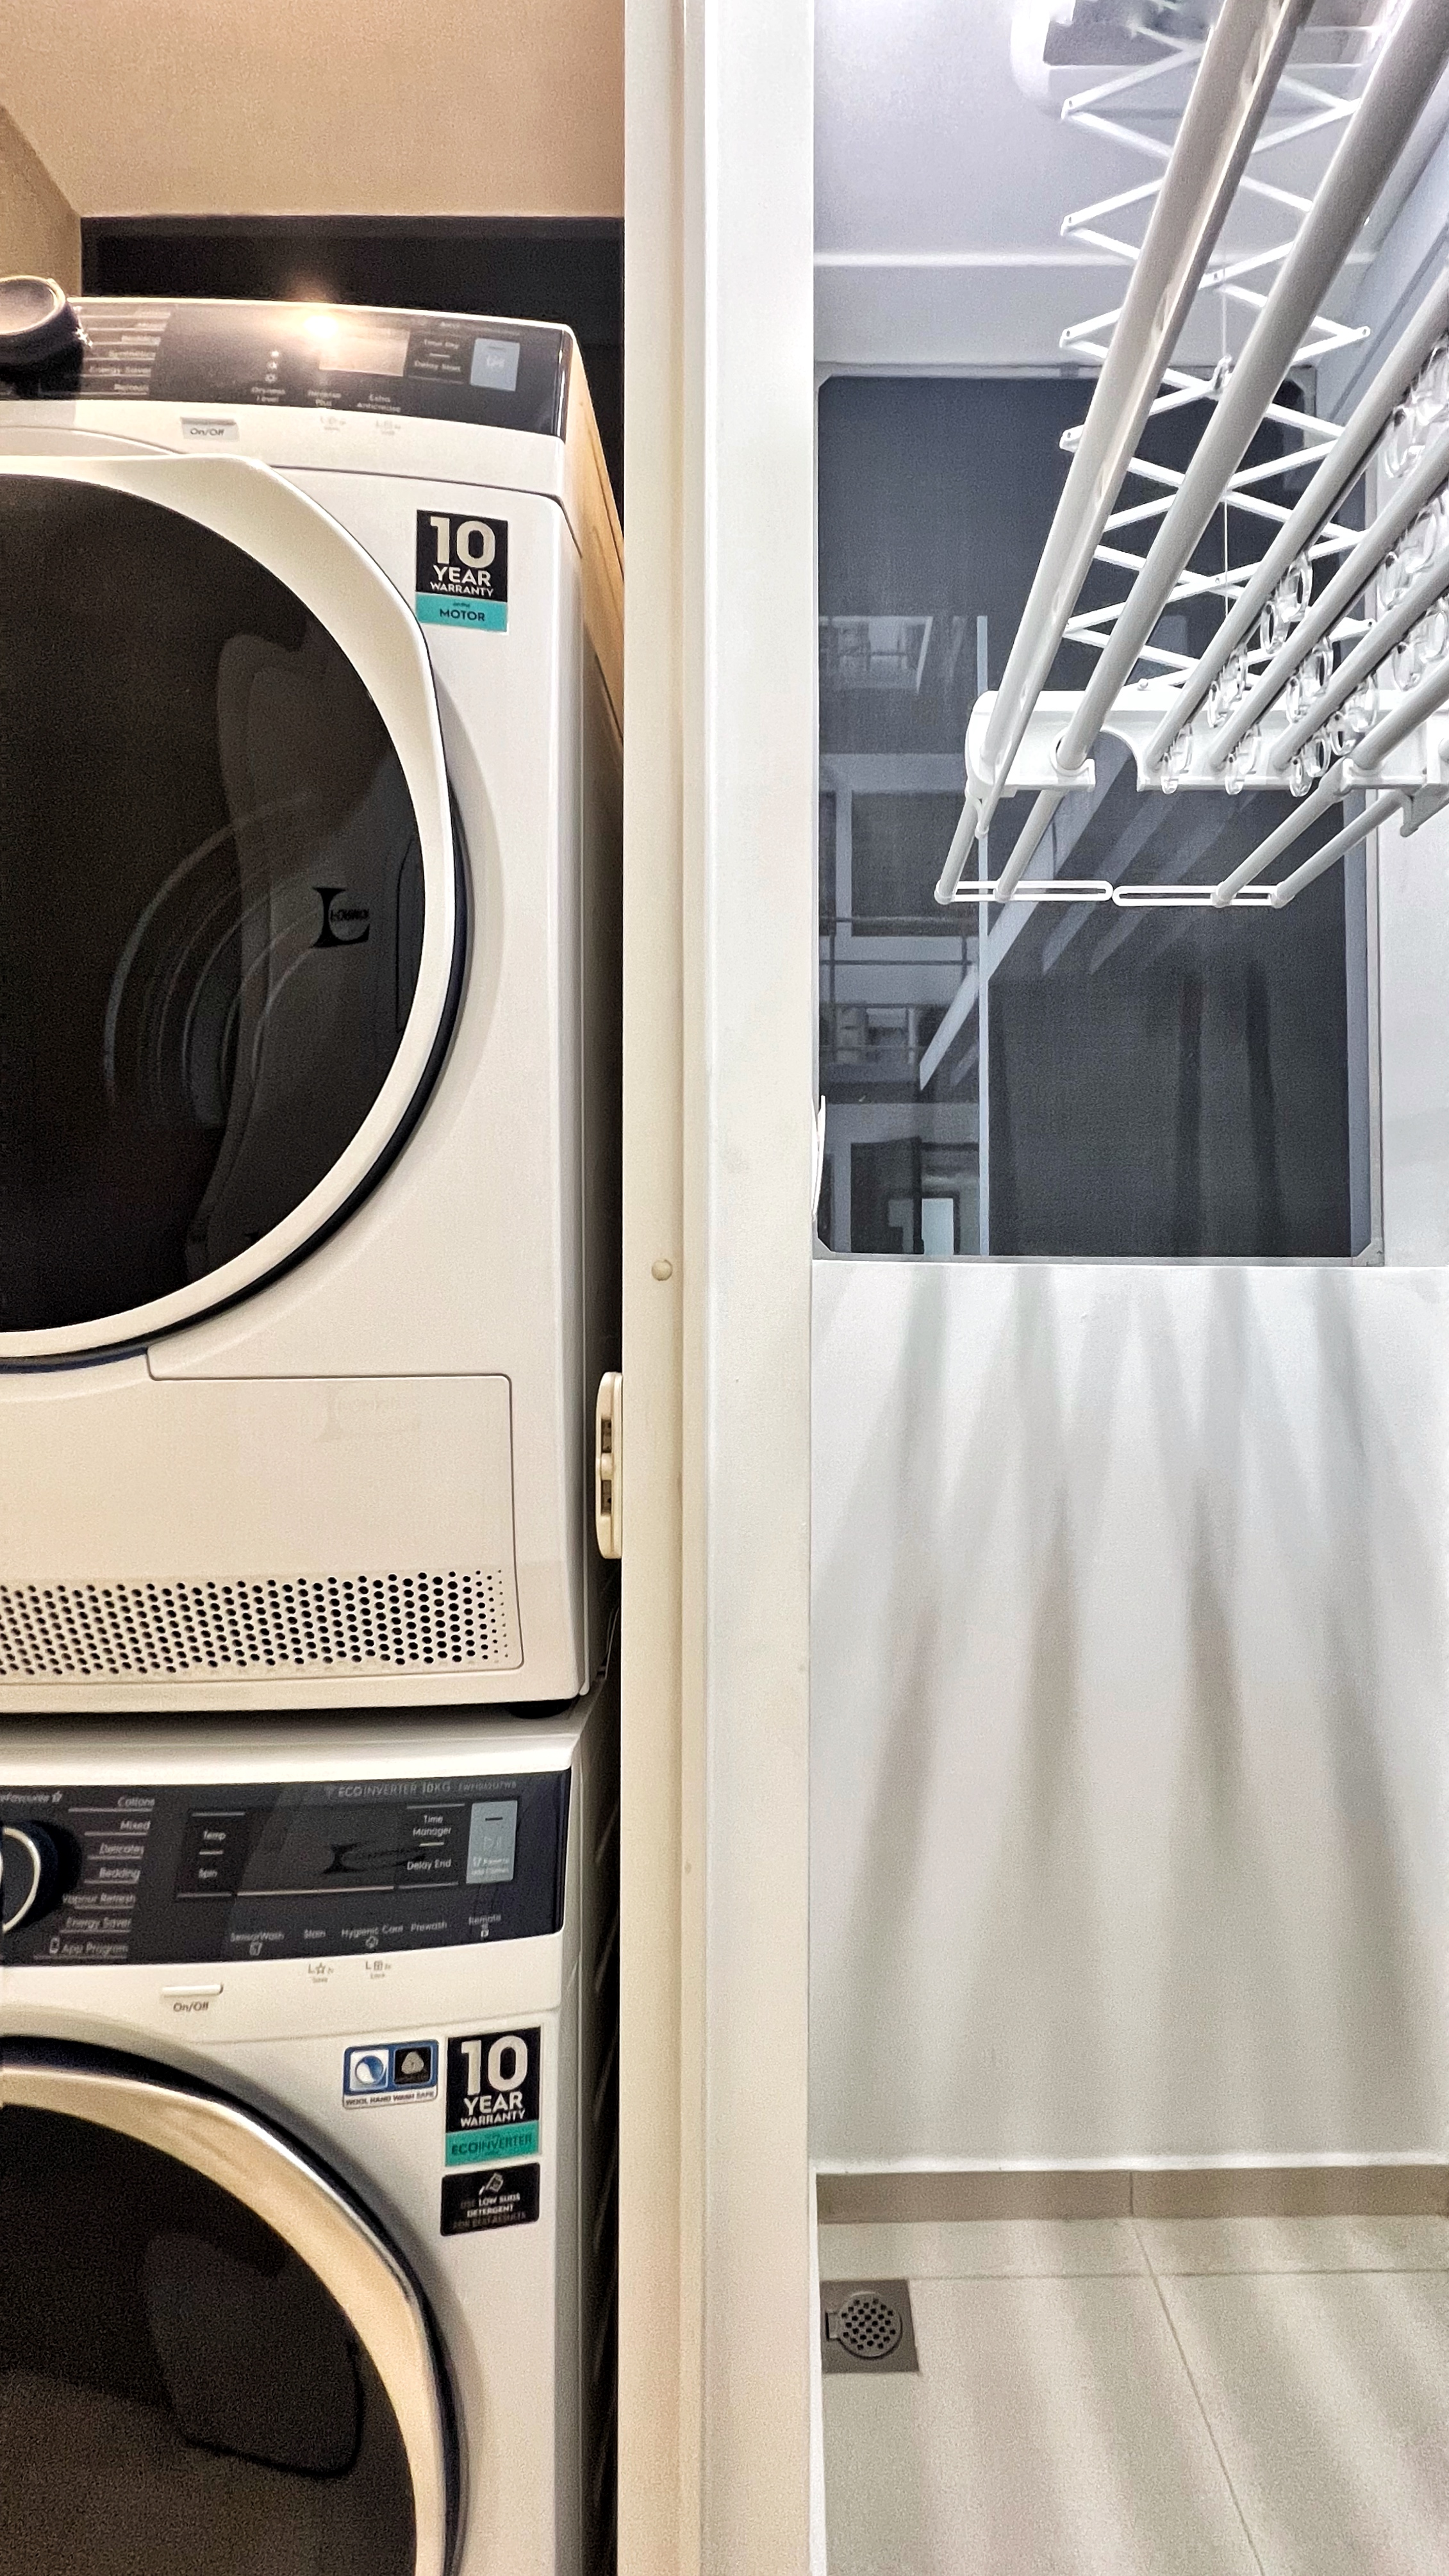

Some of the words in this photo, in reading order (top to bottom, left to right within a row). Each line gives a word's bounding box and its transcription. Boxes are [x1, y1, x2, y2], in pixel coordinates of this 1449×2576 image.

[190, 427, 225, 436] On/Off
[430, 516, 496, 568] 10
[433, 565, 492, 587] YEAR
[430, 581, 494, 597] WARRANTY
[440, 609, 485, 622] MOTOR
[120, 1820, 151, 1831] Mixed
[423, 1815, 443, 1824] Time
[203, 1831, 226, 1842] Temp
[412, 1826, 452, 1838] Manager
[407, 1860, 432, 1871] Delay
[435, 1858, 452, 1869] End
[99, 1867, 141, 1882] Bedding
[411, 1919, 448, 1932] Prewash
[468, 1913, 502, 1926] Remote
[172, 2001, 210, 2013] On/Off
[461, 2035, 528, 2096] 10
[463, 2090, 524, 2116] YEAR
[460, 2108, 526, 2129] WARRANTY
[451, 2133, 532, 2156] ECOINVERTER
[479, 2195, 498, 2207] LOW
[499, 2192, 521, 2203] SUDS
[467, 2204, 514, 2218] DETERGENT
